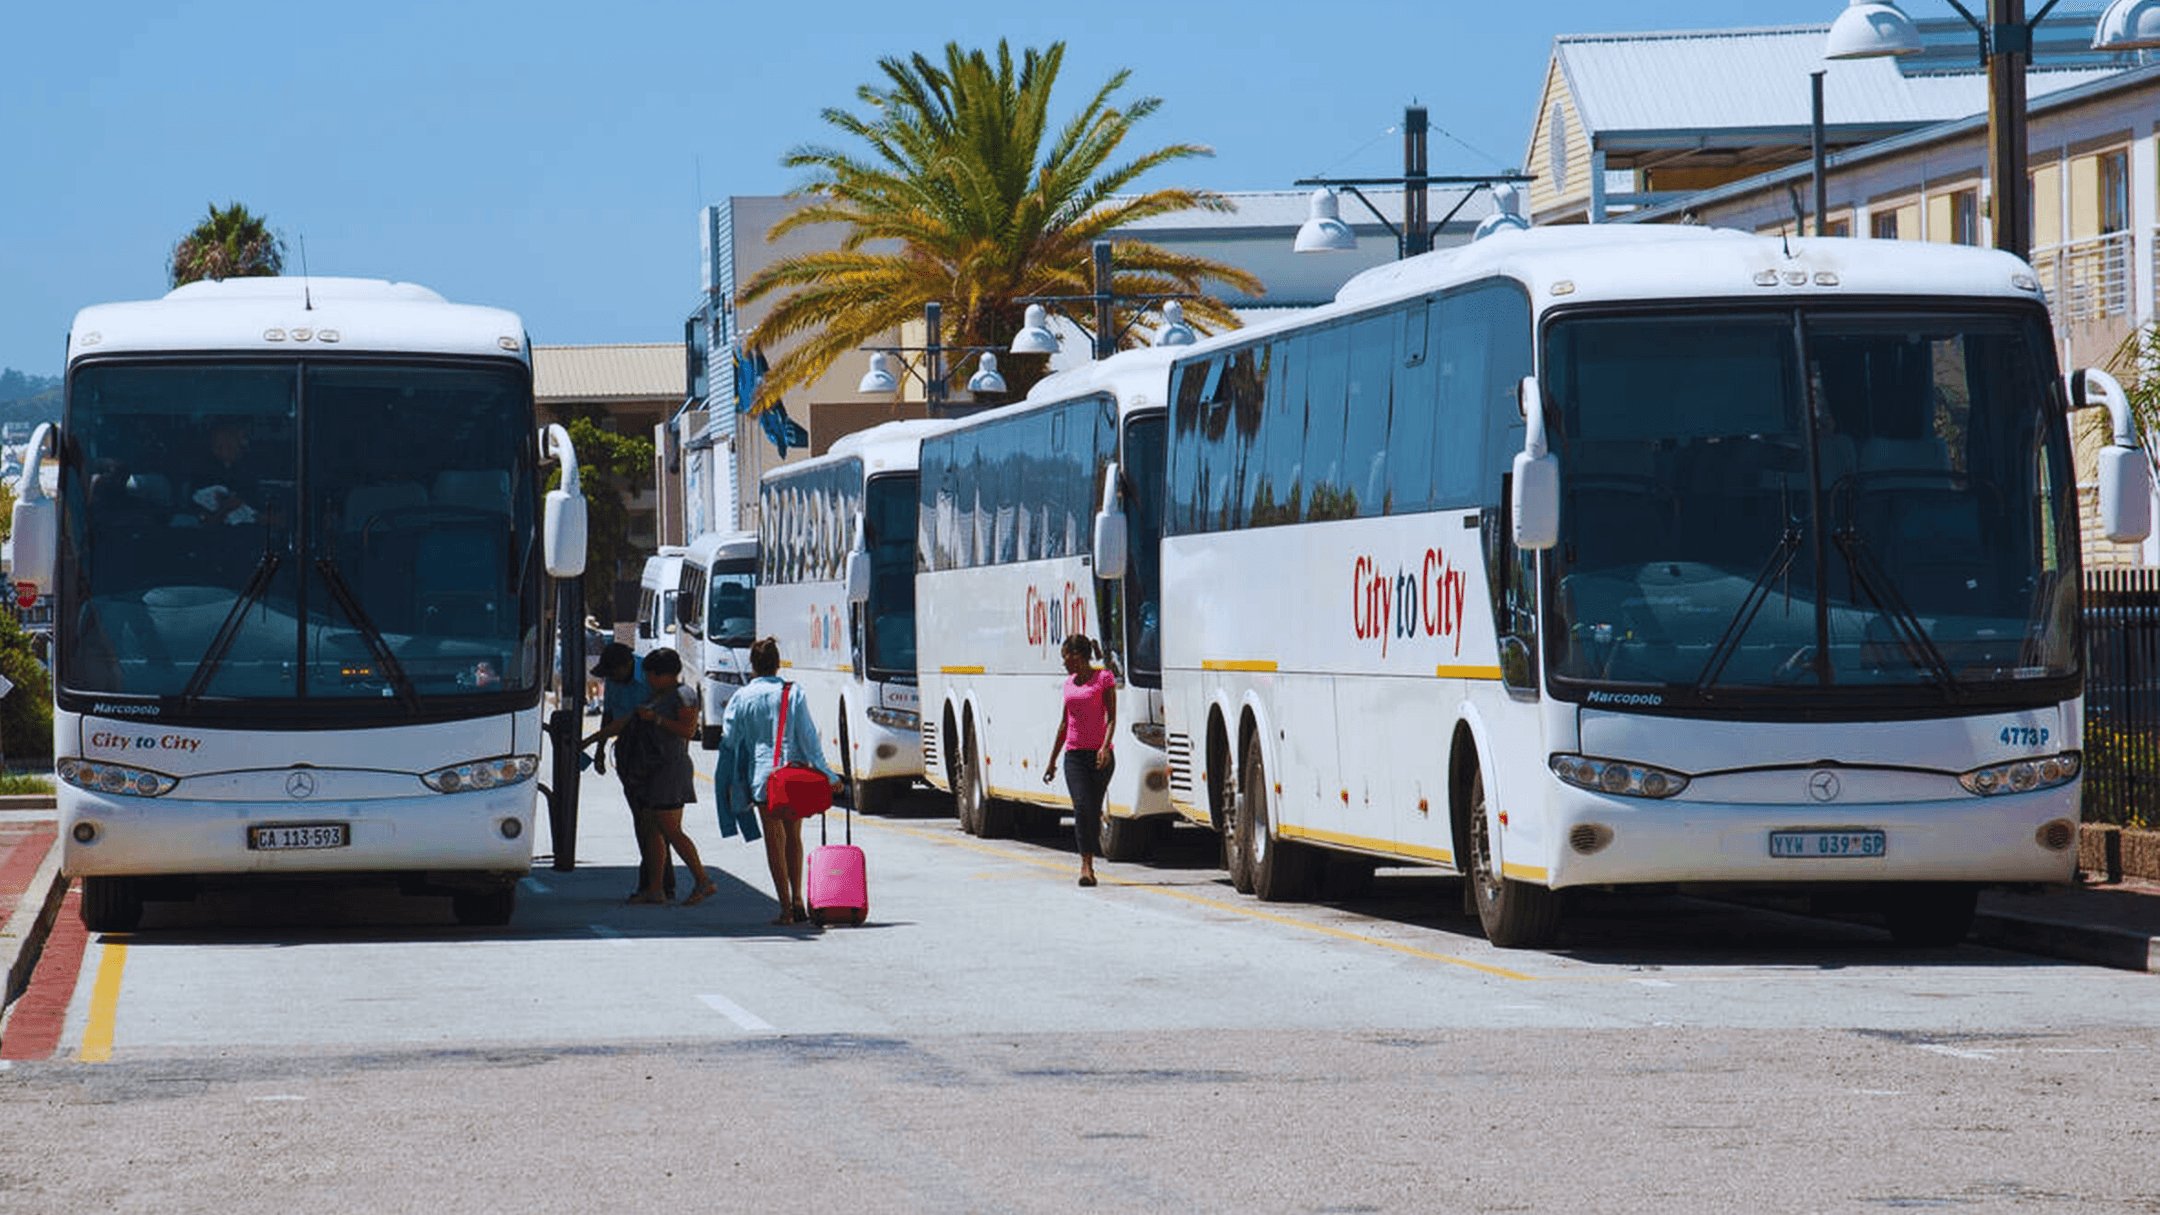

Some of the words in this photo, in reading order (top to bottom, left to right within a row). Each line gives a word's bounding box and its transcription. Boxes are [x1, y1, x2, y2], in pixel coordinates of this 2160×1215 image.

[1354, 555, 1393, 660] City
[1396, 563, 1417, 639] to
[1422, 546, 1466, 658] City
[1026, 585, 1048, 661] City
[1049, 594, 1062, 646] to
[1587, 690, 1662, 706] Marcopolo
[93, 702, 160, 716] Marcopolo
[92, 732, 131, 751] City
[135, 736, 156, 749] to
[160, 734, 201, 753] City
[2000, 727, 2050, 746] 4773P
[259, 831, 277, 847] CA
[283, 828, 340, 847] 113-593
[1819, 836, 1849, 853] 039
[1861, 836, 1883, 853] GP
